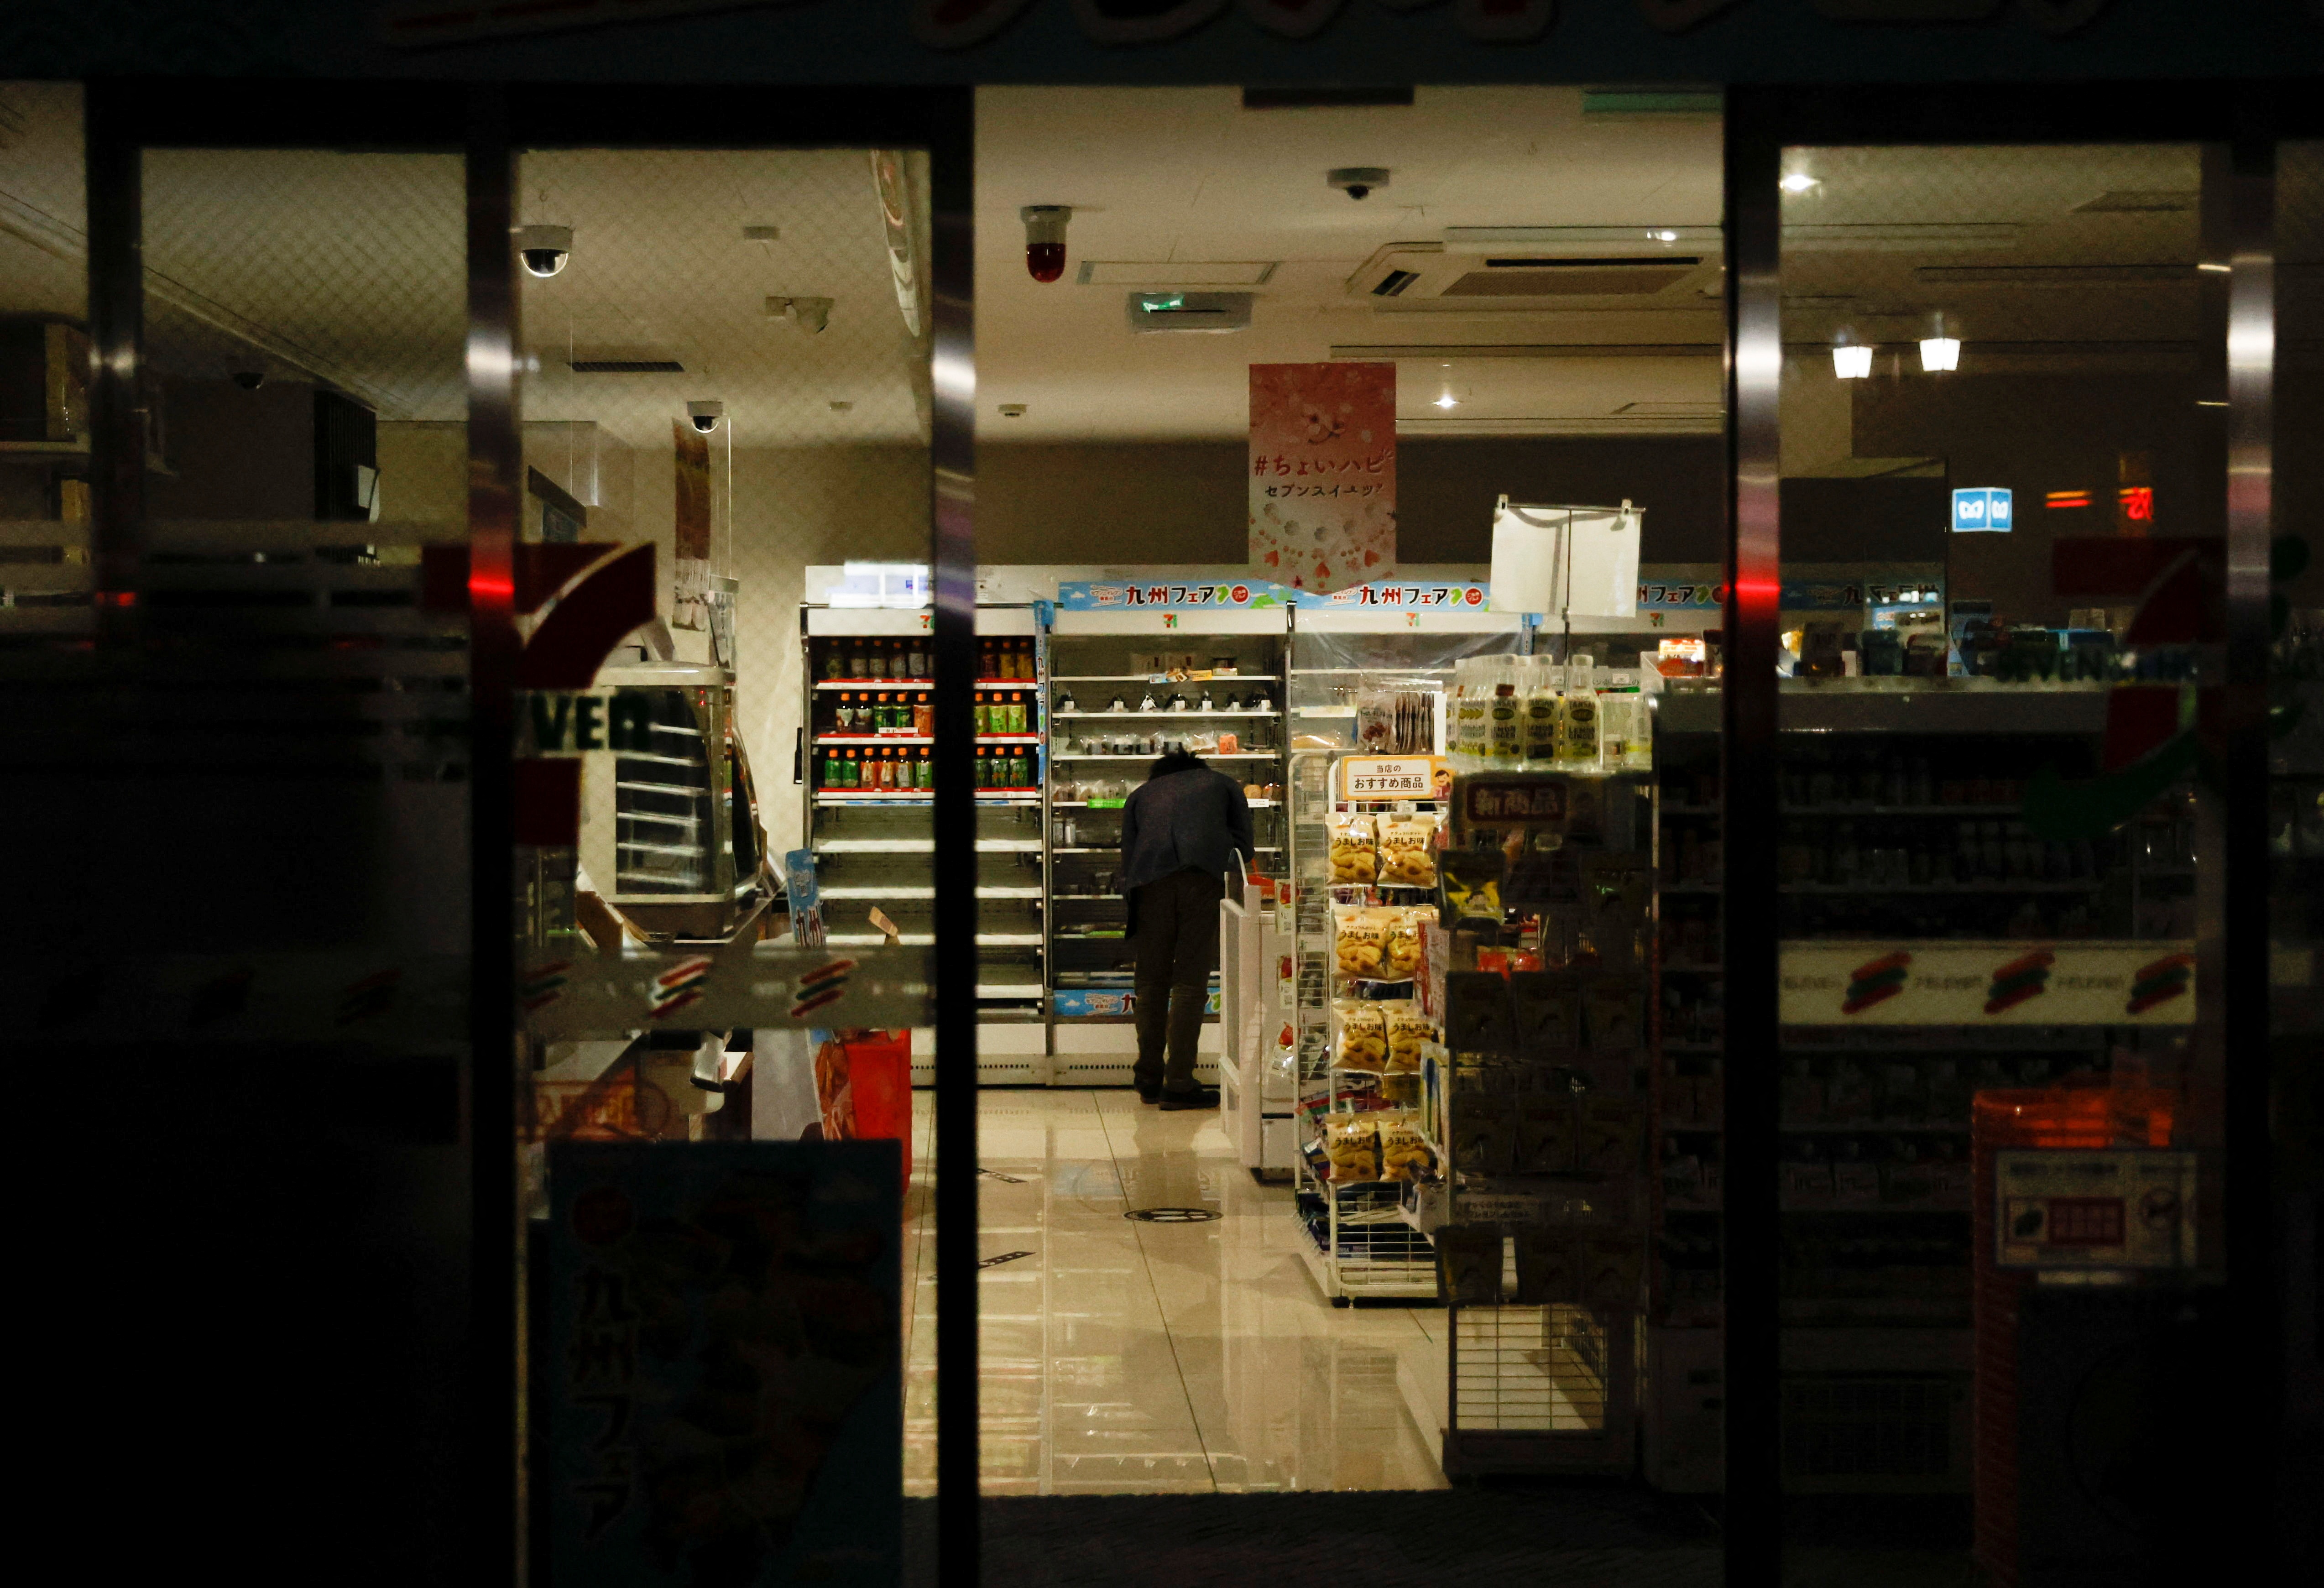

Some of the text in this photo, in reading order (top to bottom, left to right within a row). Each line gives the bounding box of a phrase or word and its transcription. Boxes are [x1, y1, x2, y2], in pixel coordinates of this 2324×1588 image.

[1126, 586, 1214, 605] 九州フェア
[1359, 586, 1448, 606] 九州フェア
[1376, 764, 1401, 773] 当店の
[1354, 777, 1423, 789] おすすめ商品
[1475, 788, 1558, 815] 新商品
[1335, 837, 1374, 846] うましお味
[1386, 837, 1425, 845] うましお味
[1341, 930, 1379, 940] うましお味
